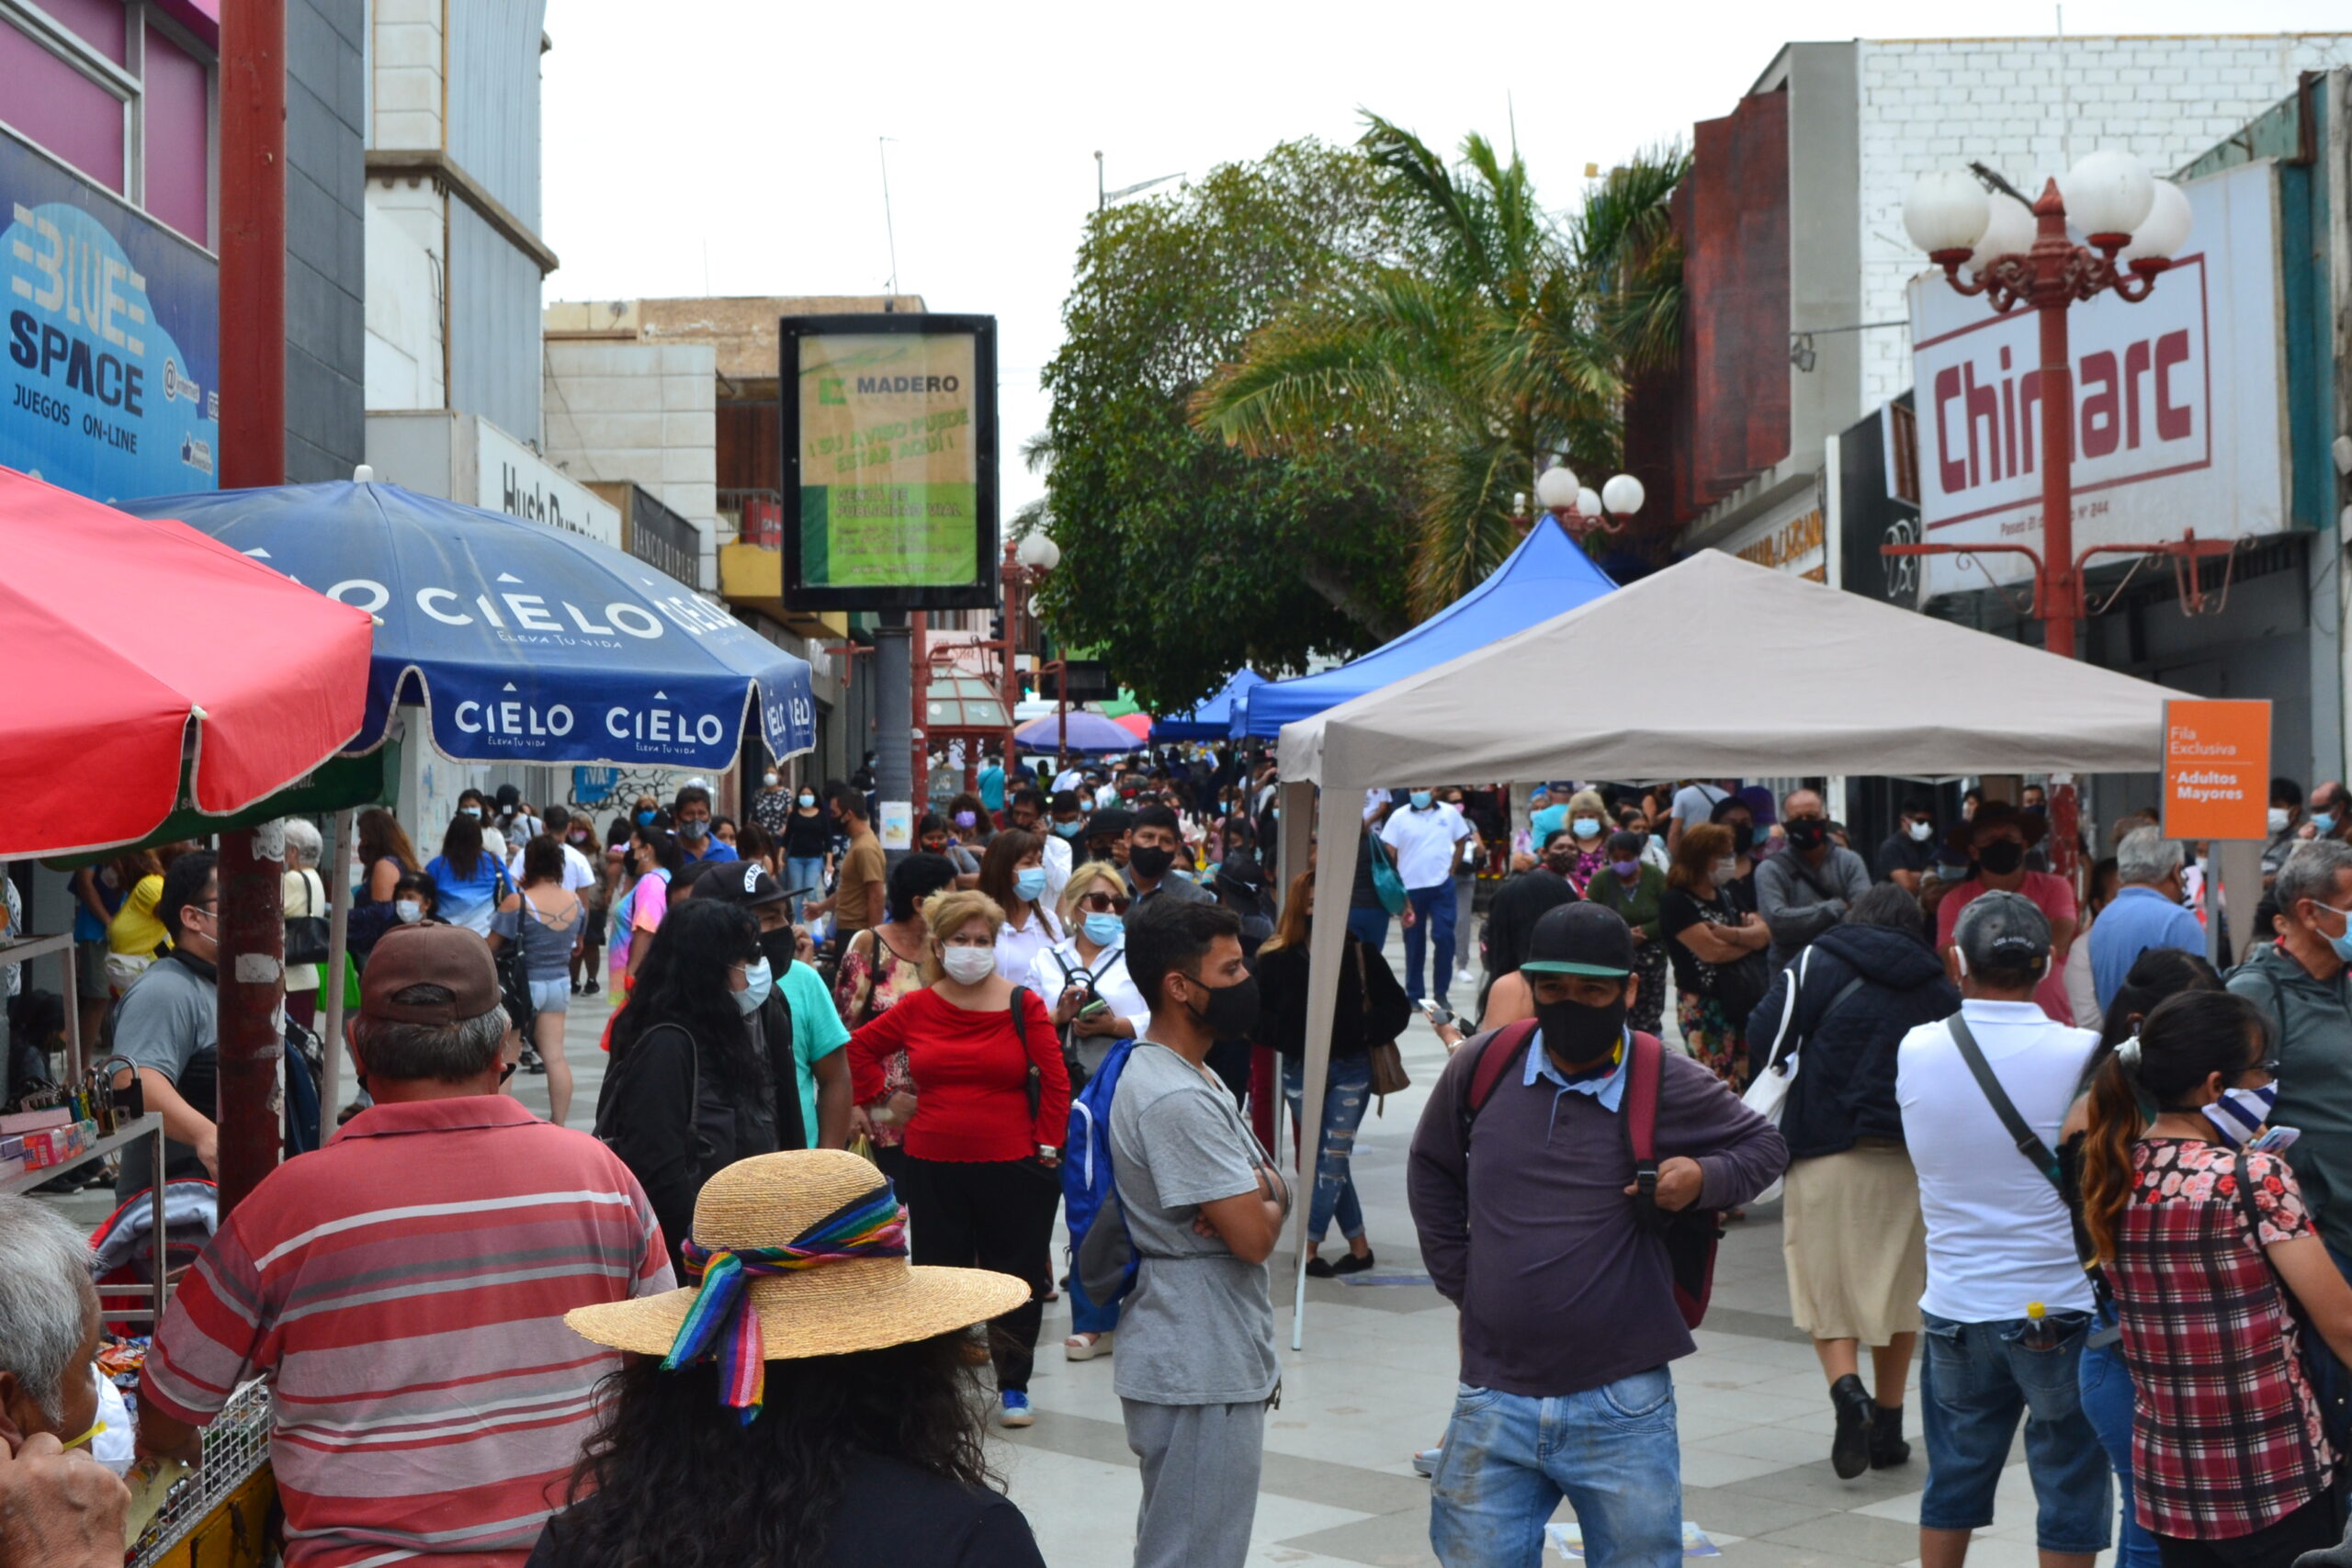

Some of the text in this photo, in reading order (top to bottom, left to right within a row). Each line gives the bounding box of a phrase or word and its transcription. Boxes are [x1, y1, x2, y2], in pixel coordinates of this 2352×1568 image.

[12, 202, 145, 357] BLUE
[10, 310, 144, 418] SPACE
[857, 376, 959, 393] MADERO
[14, 384, 137, 455] JUEGOS ON-LINE
[910, 408, 969, 434] PUEDE
[503, 462, 545, 523] Hush
[416, 586, 664, 639] CIELO
[455, 700, 574, 736] CIELO
[605, 705, 723, 746] CIELO
[2170, 726, 2197, 740] Fila
[2170, 741, 2236, 756] Exclusiva
[2177, 771, 2237, 784] Adultos
[2177, 786, 2244, 803] Mayores
